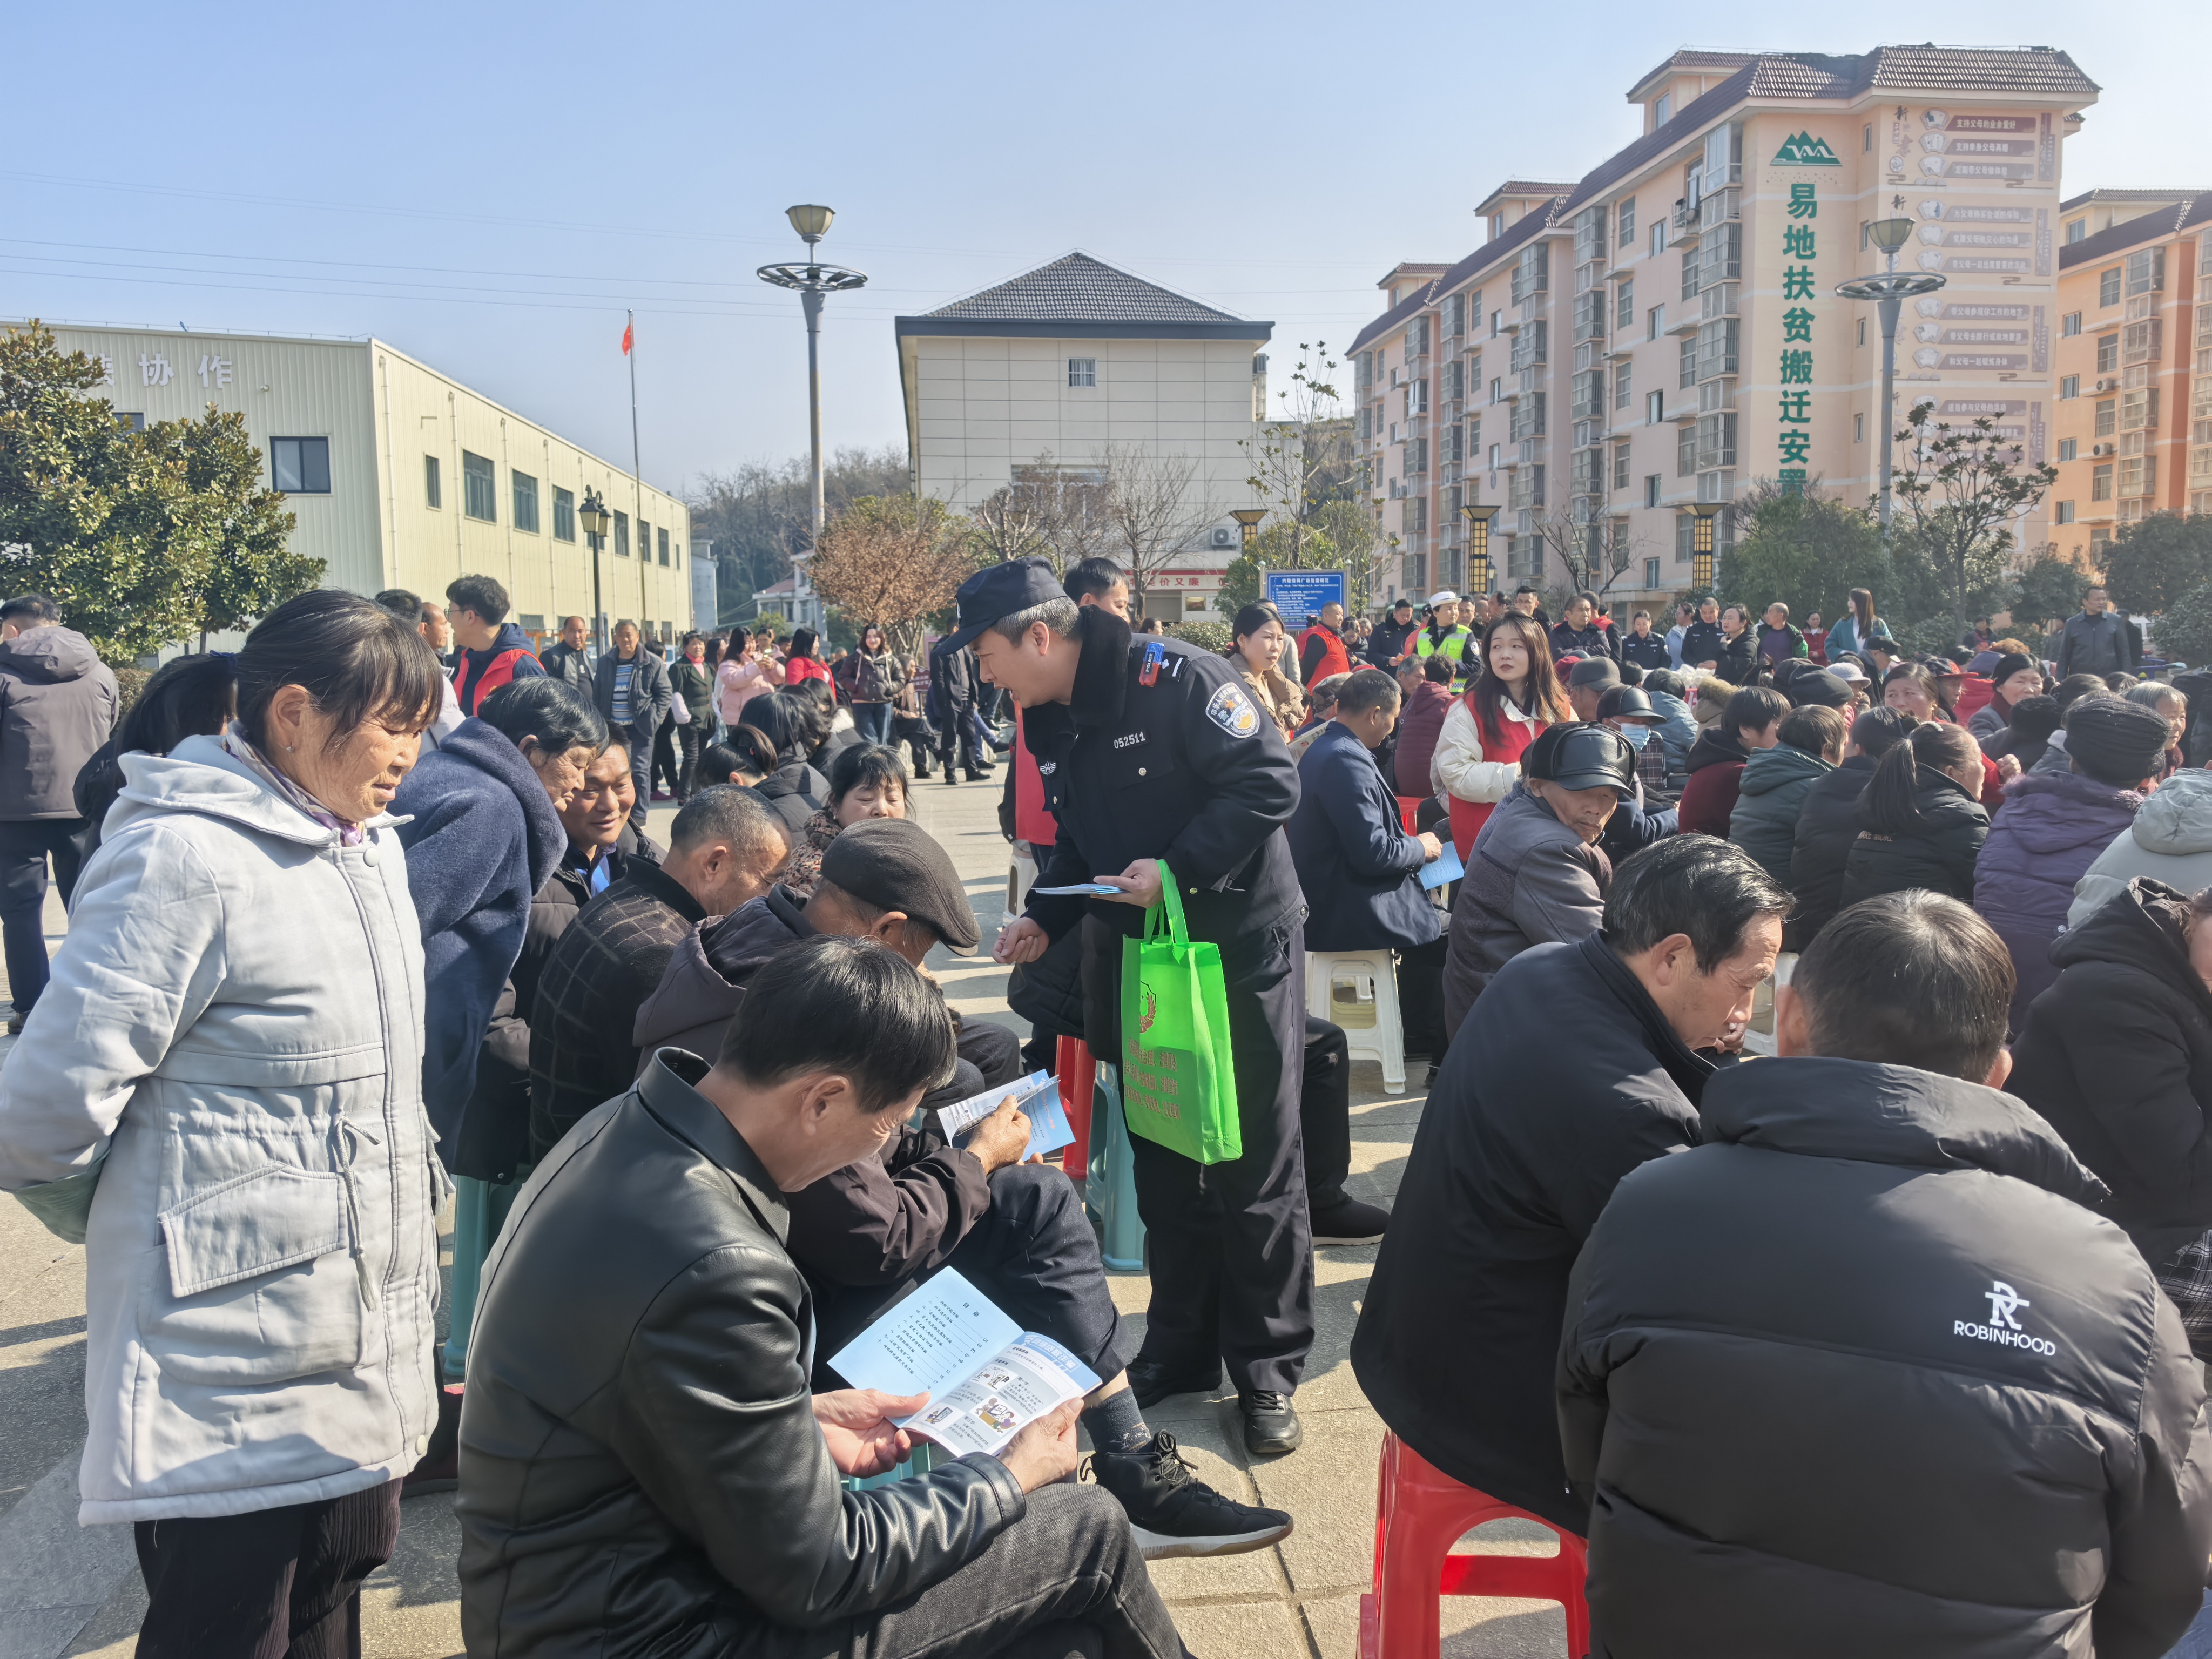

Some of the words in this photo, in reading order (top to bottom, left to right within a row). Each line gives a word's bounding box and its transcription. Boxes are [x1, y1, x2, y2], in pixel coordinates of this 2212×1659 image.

[1777, 183, 1818, 502] 易地扶贫搬迁安置
[1145, 653, 1154, 673] POLICE
[1114, 731, 1146, 749] 052511
[1953, 1320, 2056, 1357] ROBINHOOD
